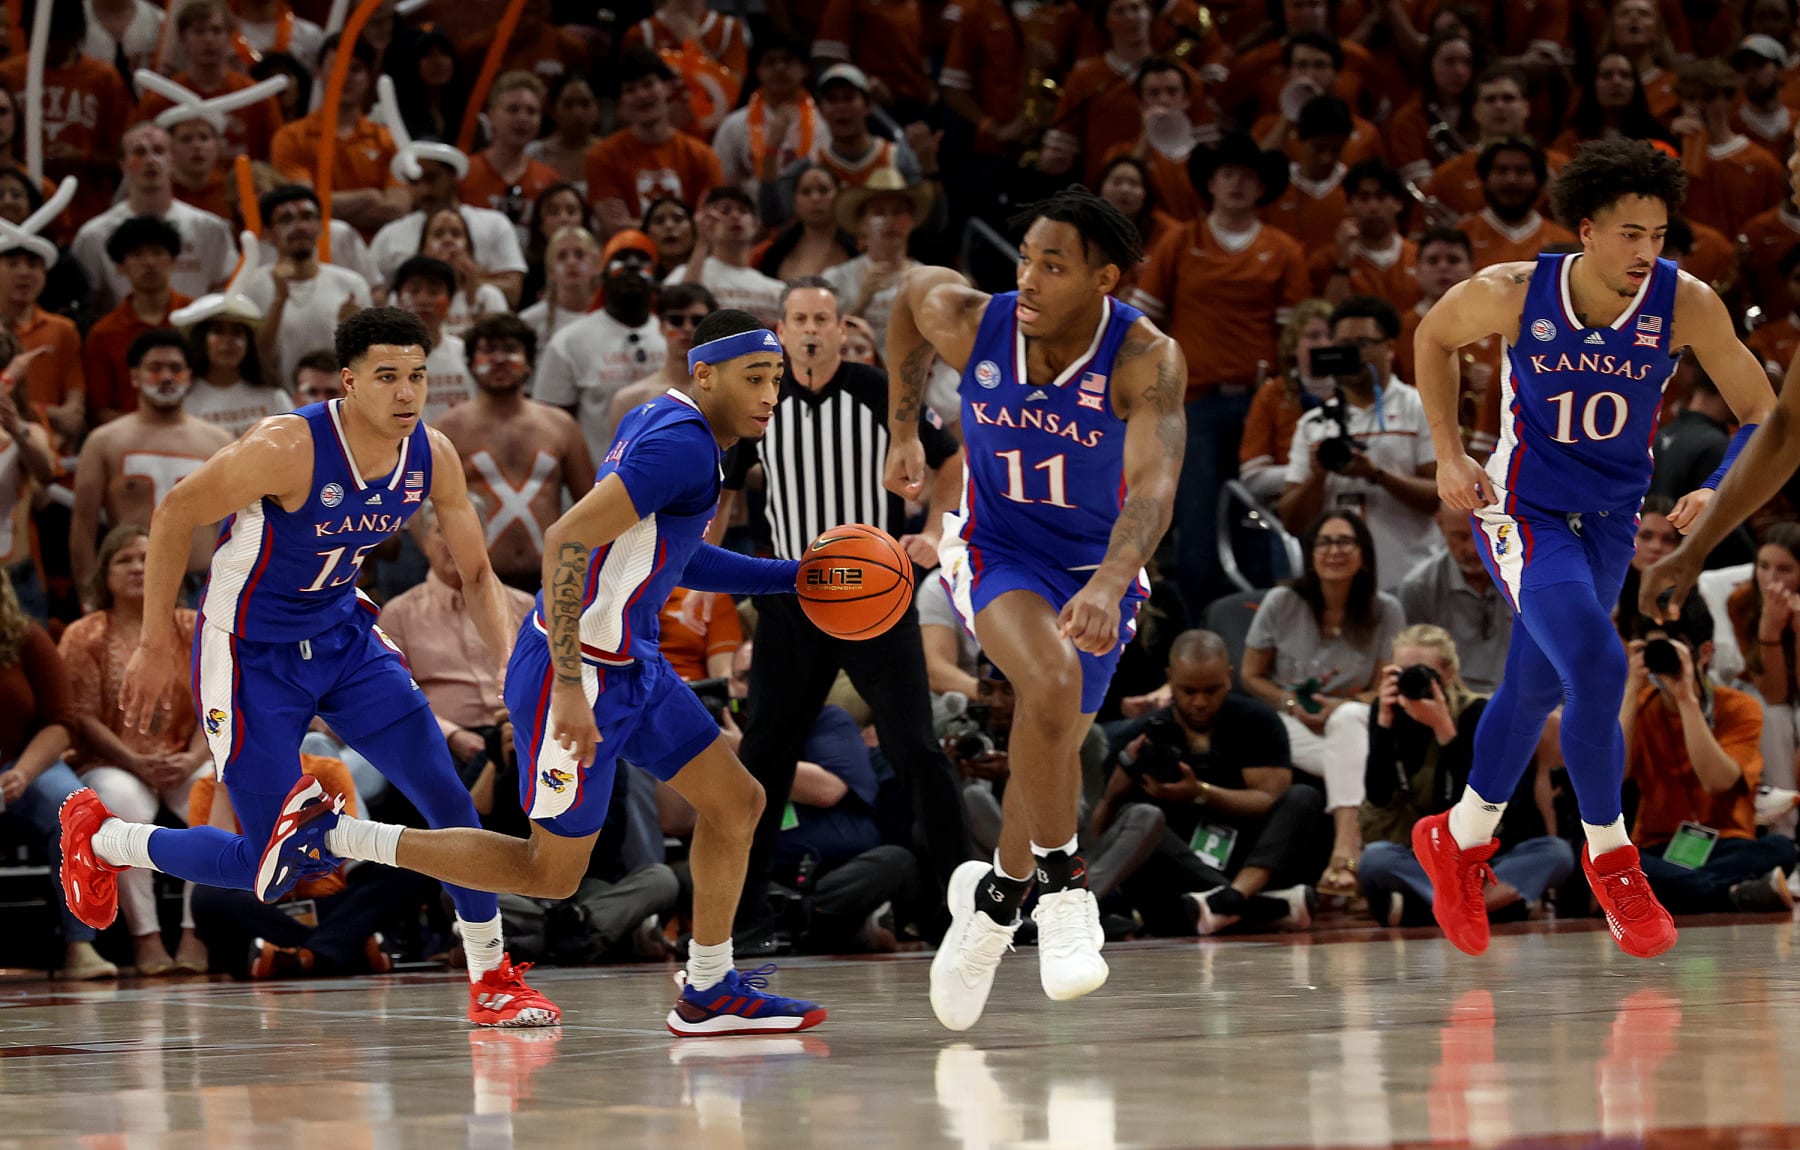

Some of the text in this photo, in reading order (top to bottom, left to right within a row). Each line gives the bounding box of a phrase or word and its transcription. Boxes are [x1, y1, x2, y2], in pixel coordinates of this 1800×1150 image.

[14, 86, 98, 129] TXAS
[1529, 352, 1652, 381] KANSAS
[970, 402, 1105, 448] KANSAS
[1546, 390, 1630, 444] 10
[995, 449, 1079, 509] 11
[470, 449, 559, 557] X
[298, 542, 381, 592] 15
[806, 567, 863, 585] ELITE
[1204, 833, 1219, 852] P
[987, 882, 1005, 903] 13
